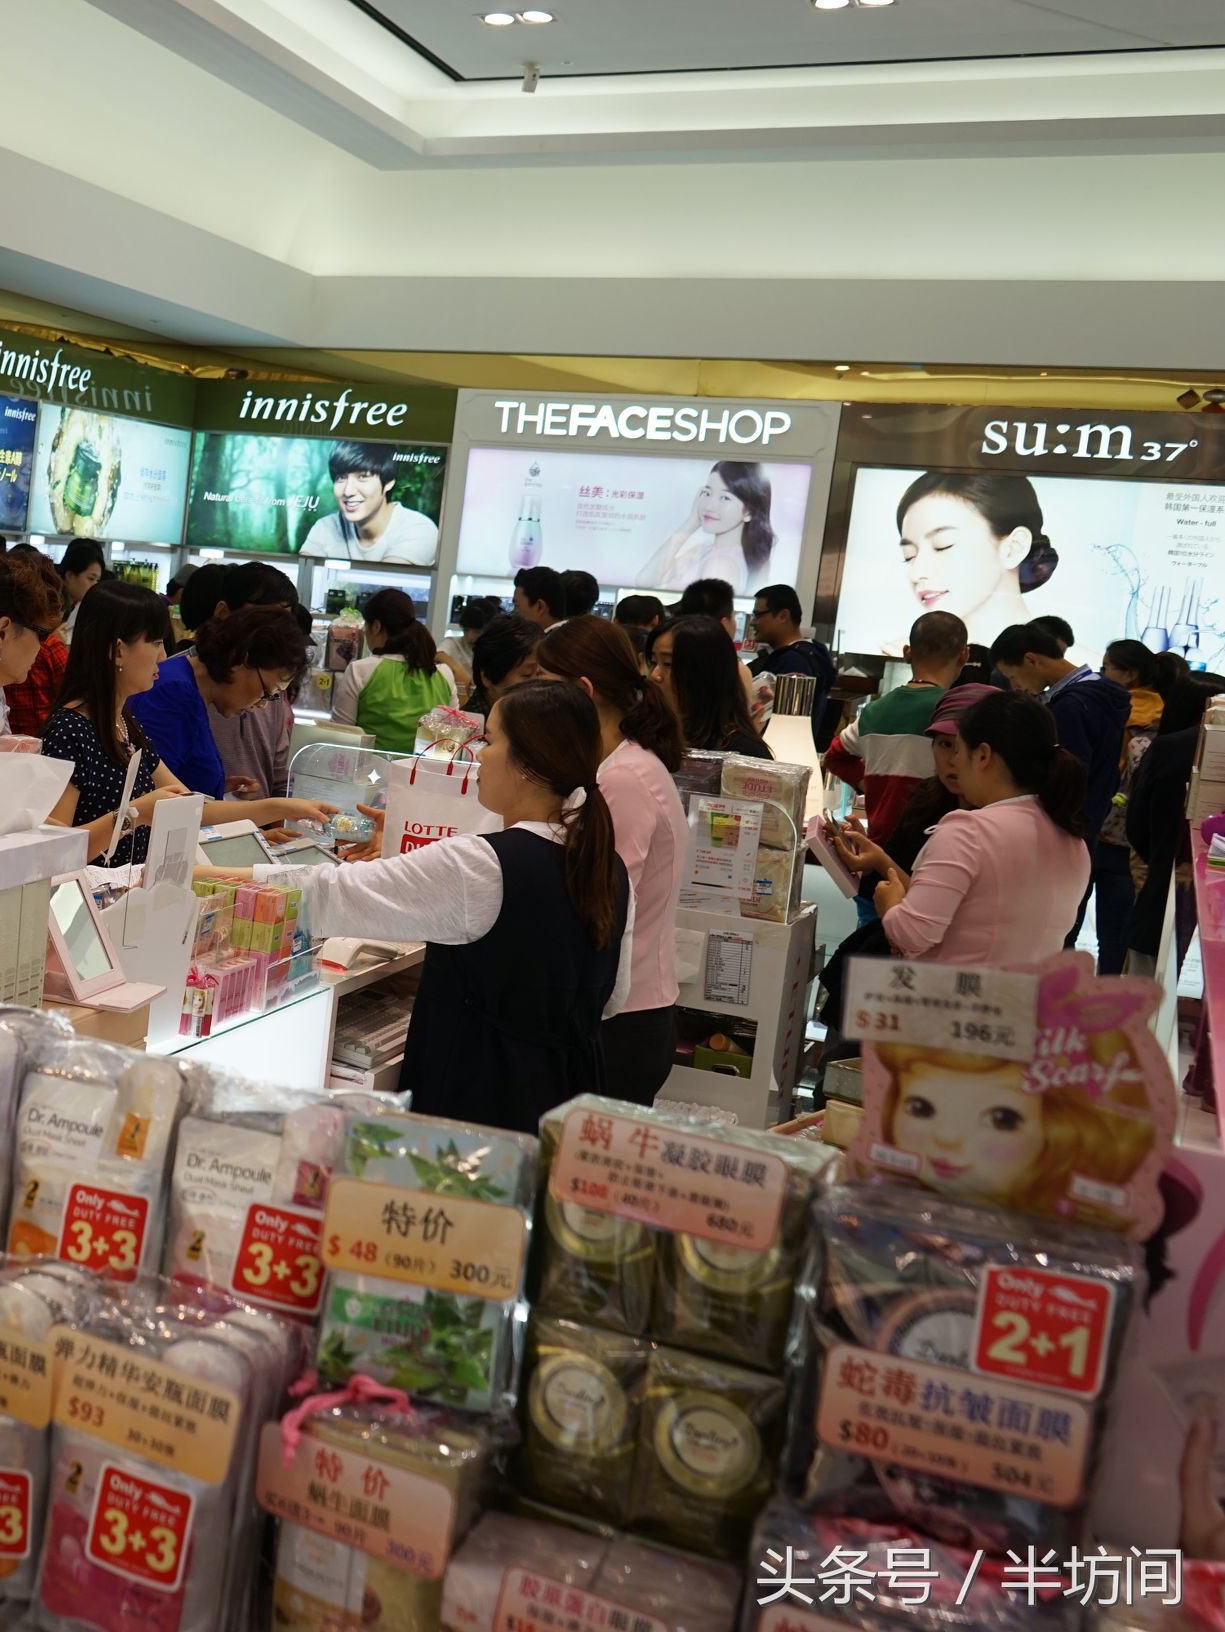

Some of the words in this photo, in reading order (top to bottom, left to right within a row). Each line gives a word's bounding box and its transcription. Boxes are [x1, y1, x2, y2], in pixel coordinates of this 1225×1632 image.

[4, 406, 36, 422] innisfree
[239, 389, 408, 431] innisfree
[494, 401, 791, 445] THEFACESHOP
[981, 418, 1134, 461] su:m
[392, 452, 441, 465] innisfree
[404, 821, 459, 838] LOTTE
[28, 1107, 45, 1124] Dr.
[47, 1114, 103, 1138] Ampoule
[186, 1152, 205, 1170] Dr.
[208, 1157, 272, 1185] Ampoule
[75, 1189, 105, 1209] Only
[73, 1206, 102, 1222] DUTY
[105, 1214, 135, 1230] FREE
[254, 1211, 288, 1234] Only
[381, 1199, 455, 1246] 特价
[67, 1221, 137, 1272] 3+3
[252, 1228, 283, 1245] DUTY
[242, 1243, 319, 1298] 3+3
[997, 1273, 1046, 1298] Only
[987, 1311, 1093, 1379] 2+1
[55, 1336, 231, 1426] 弹力精华安瓶面膜
[68, 1396, 106, 1429] $93
[839, 1418, 889, 1450] $80
[109, 1474, 143, 1498] Only
[99, 1509, 177, 1572] 3+3
